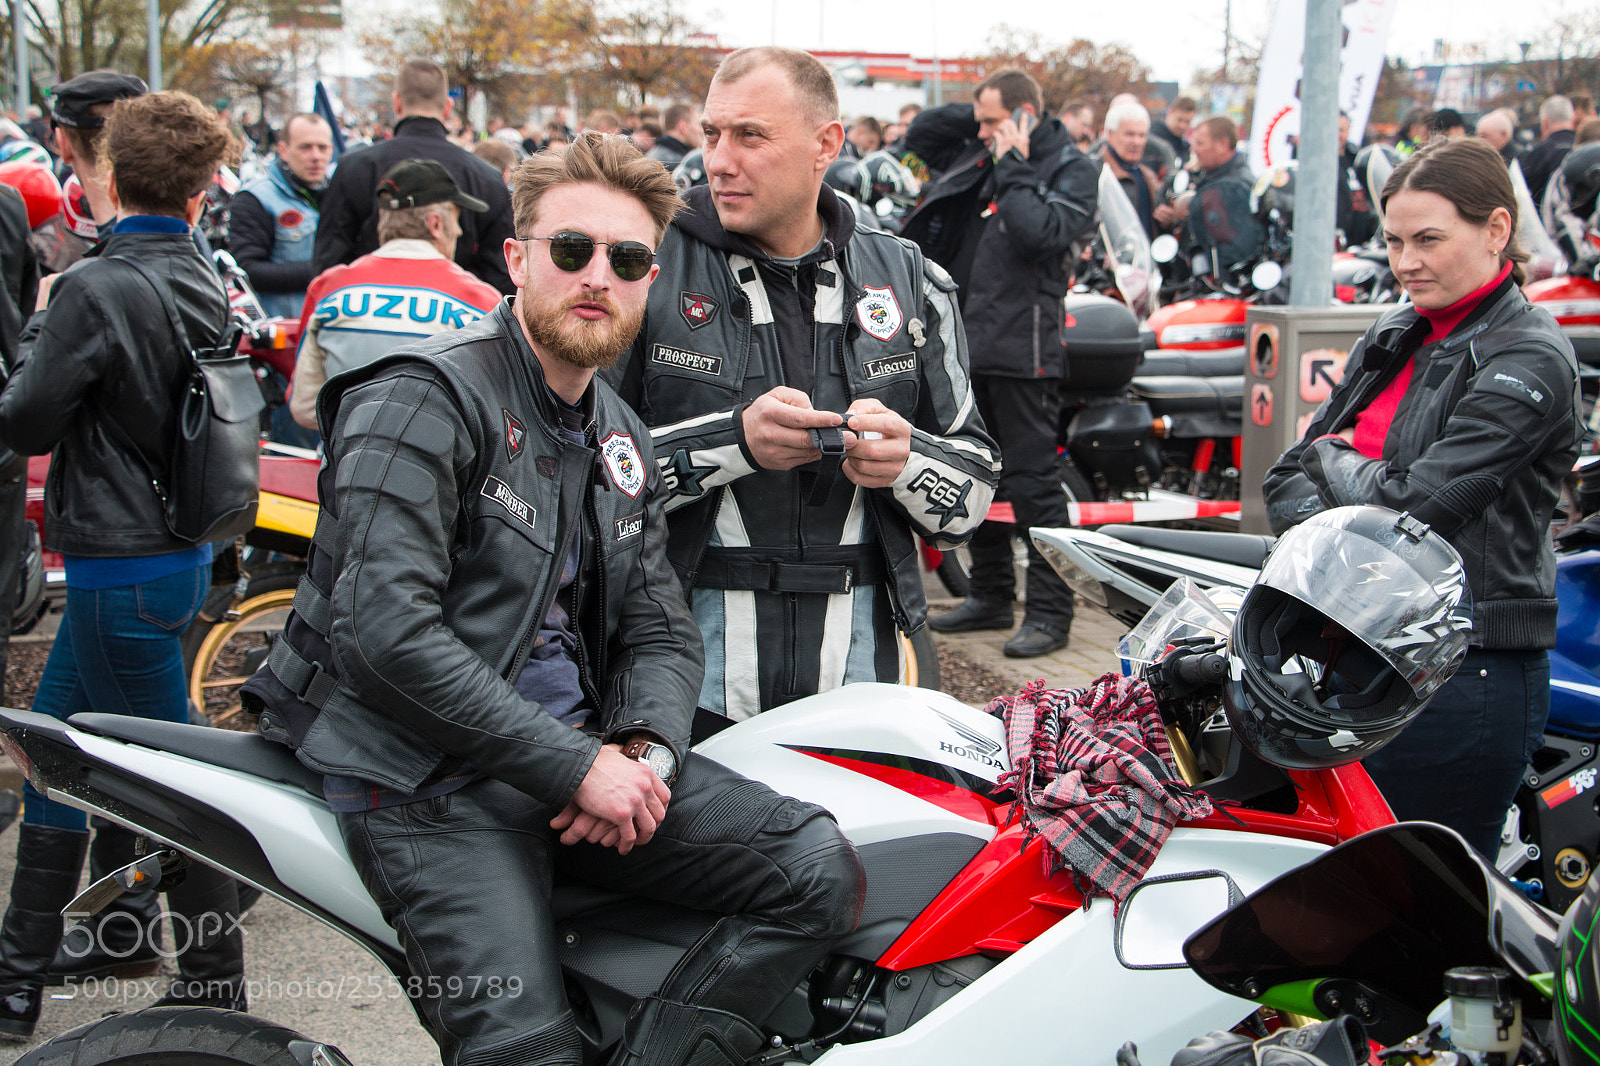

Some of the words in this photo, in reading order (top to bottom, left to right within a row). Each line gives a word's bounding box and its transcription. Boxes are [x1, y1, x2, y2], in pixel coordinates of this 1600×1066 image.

[315, 293, 480, 330] SUZUK
[690, 307, 704, 318] MC
[869, 322, 898, 335] SUPPORT
[657, 347, 716, 371] PROSPECT
[620, 476, 642, 491] SUPPORT
[912, 472, 962, 509] PGS
[493, 483, 529, 521] MEMBER
[938, 741, 1007, 772] HONDA
